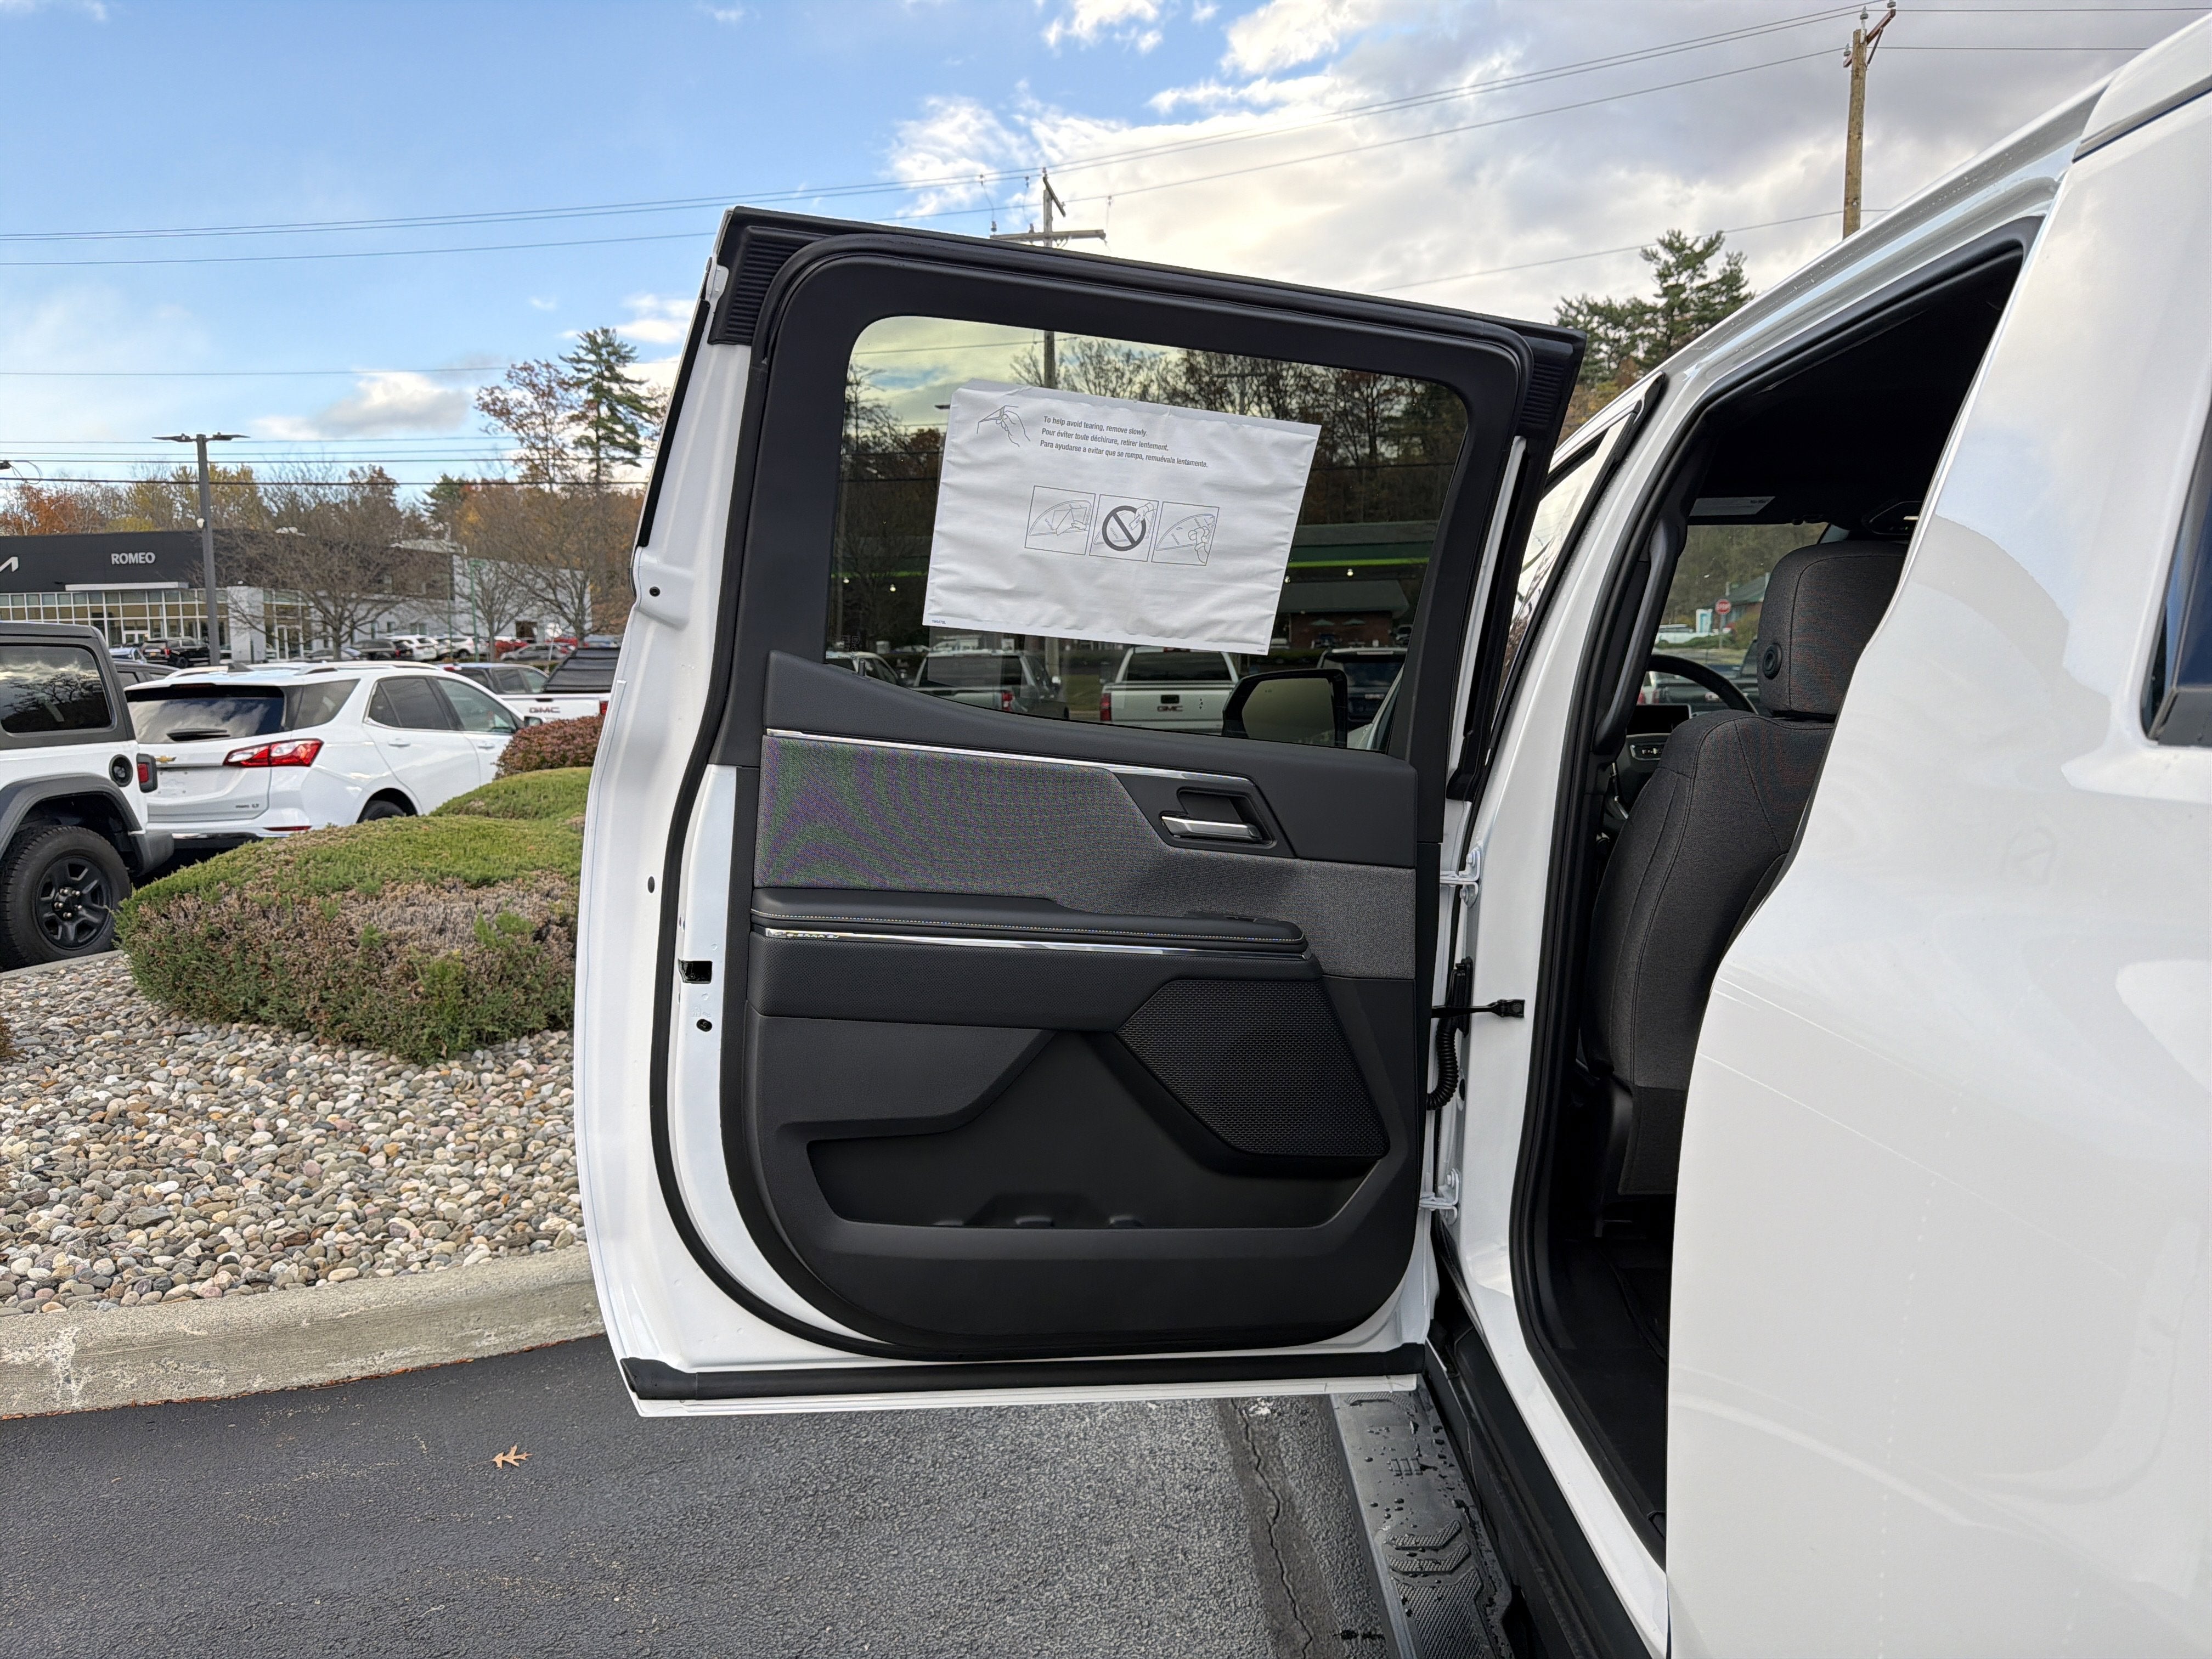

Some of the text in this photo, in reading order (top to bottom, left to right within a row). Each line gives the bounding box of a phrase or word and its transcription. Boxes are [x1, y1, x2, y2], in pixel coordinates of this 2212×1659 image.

[1052, 417, 1065, 426] help
[1084, 421, 1104, 432] tearing,
[1106, 426, 1127, 434] remove
[1128, 427, 1148, 437] slowly.
[1057, 430, 1074, 439] éviter
[1075, 432, 1090, 441] toute
[1090, 435, 1119, 445] déchirure,
[1138, 441, 1169, 451] lentement.
[1040, 439, 1053, 448] Para
[1055, 443, 1081, 452] ayudarse
[1088, 446, 1104, 456] evitar
[1125, 452, 1144, 461] rompa,
[1146, 455, 1175, 464] remuévala
[1176, 457, 1208, 468] lentamente.
[111, 552, 156, 565] ROMEO
